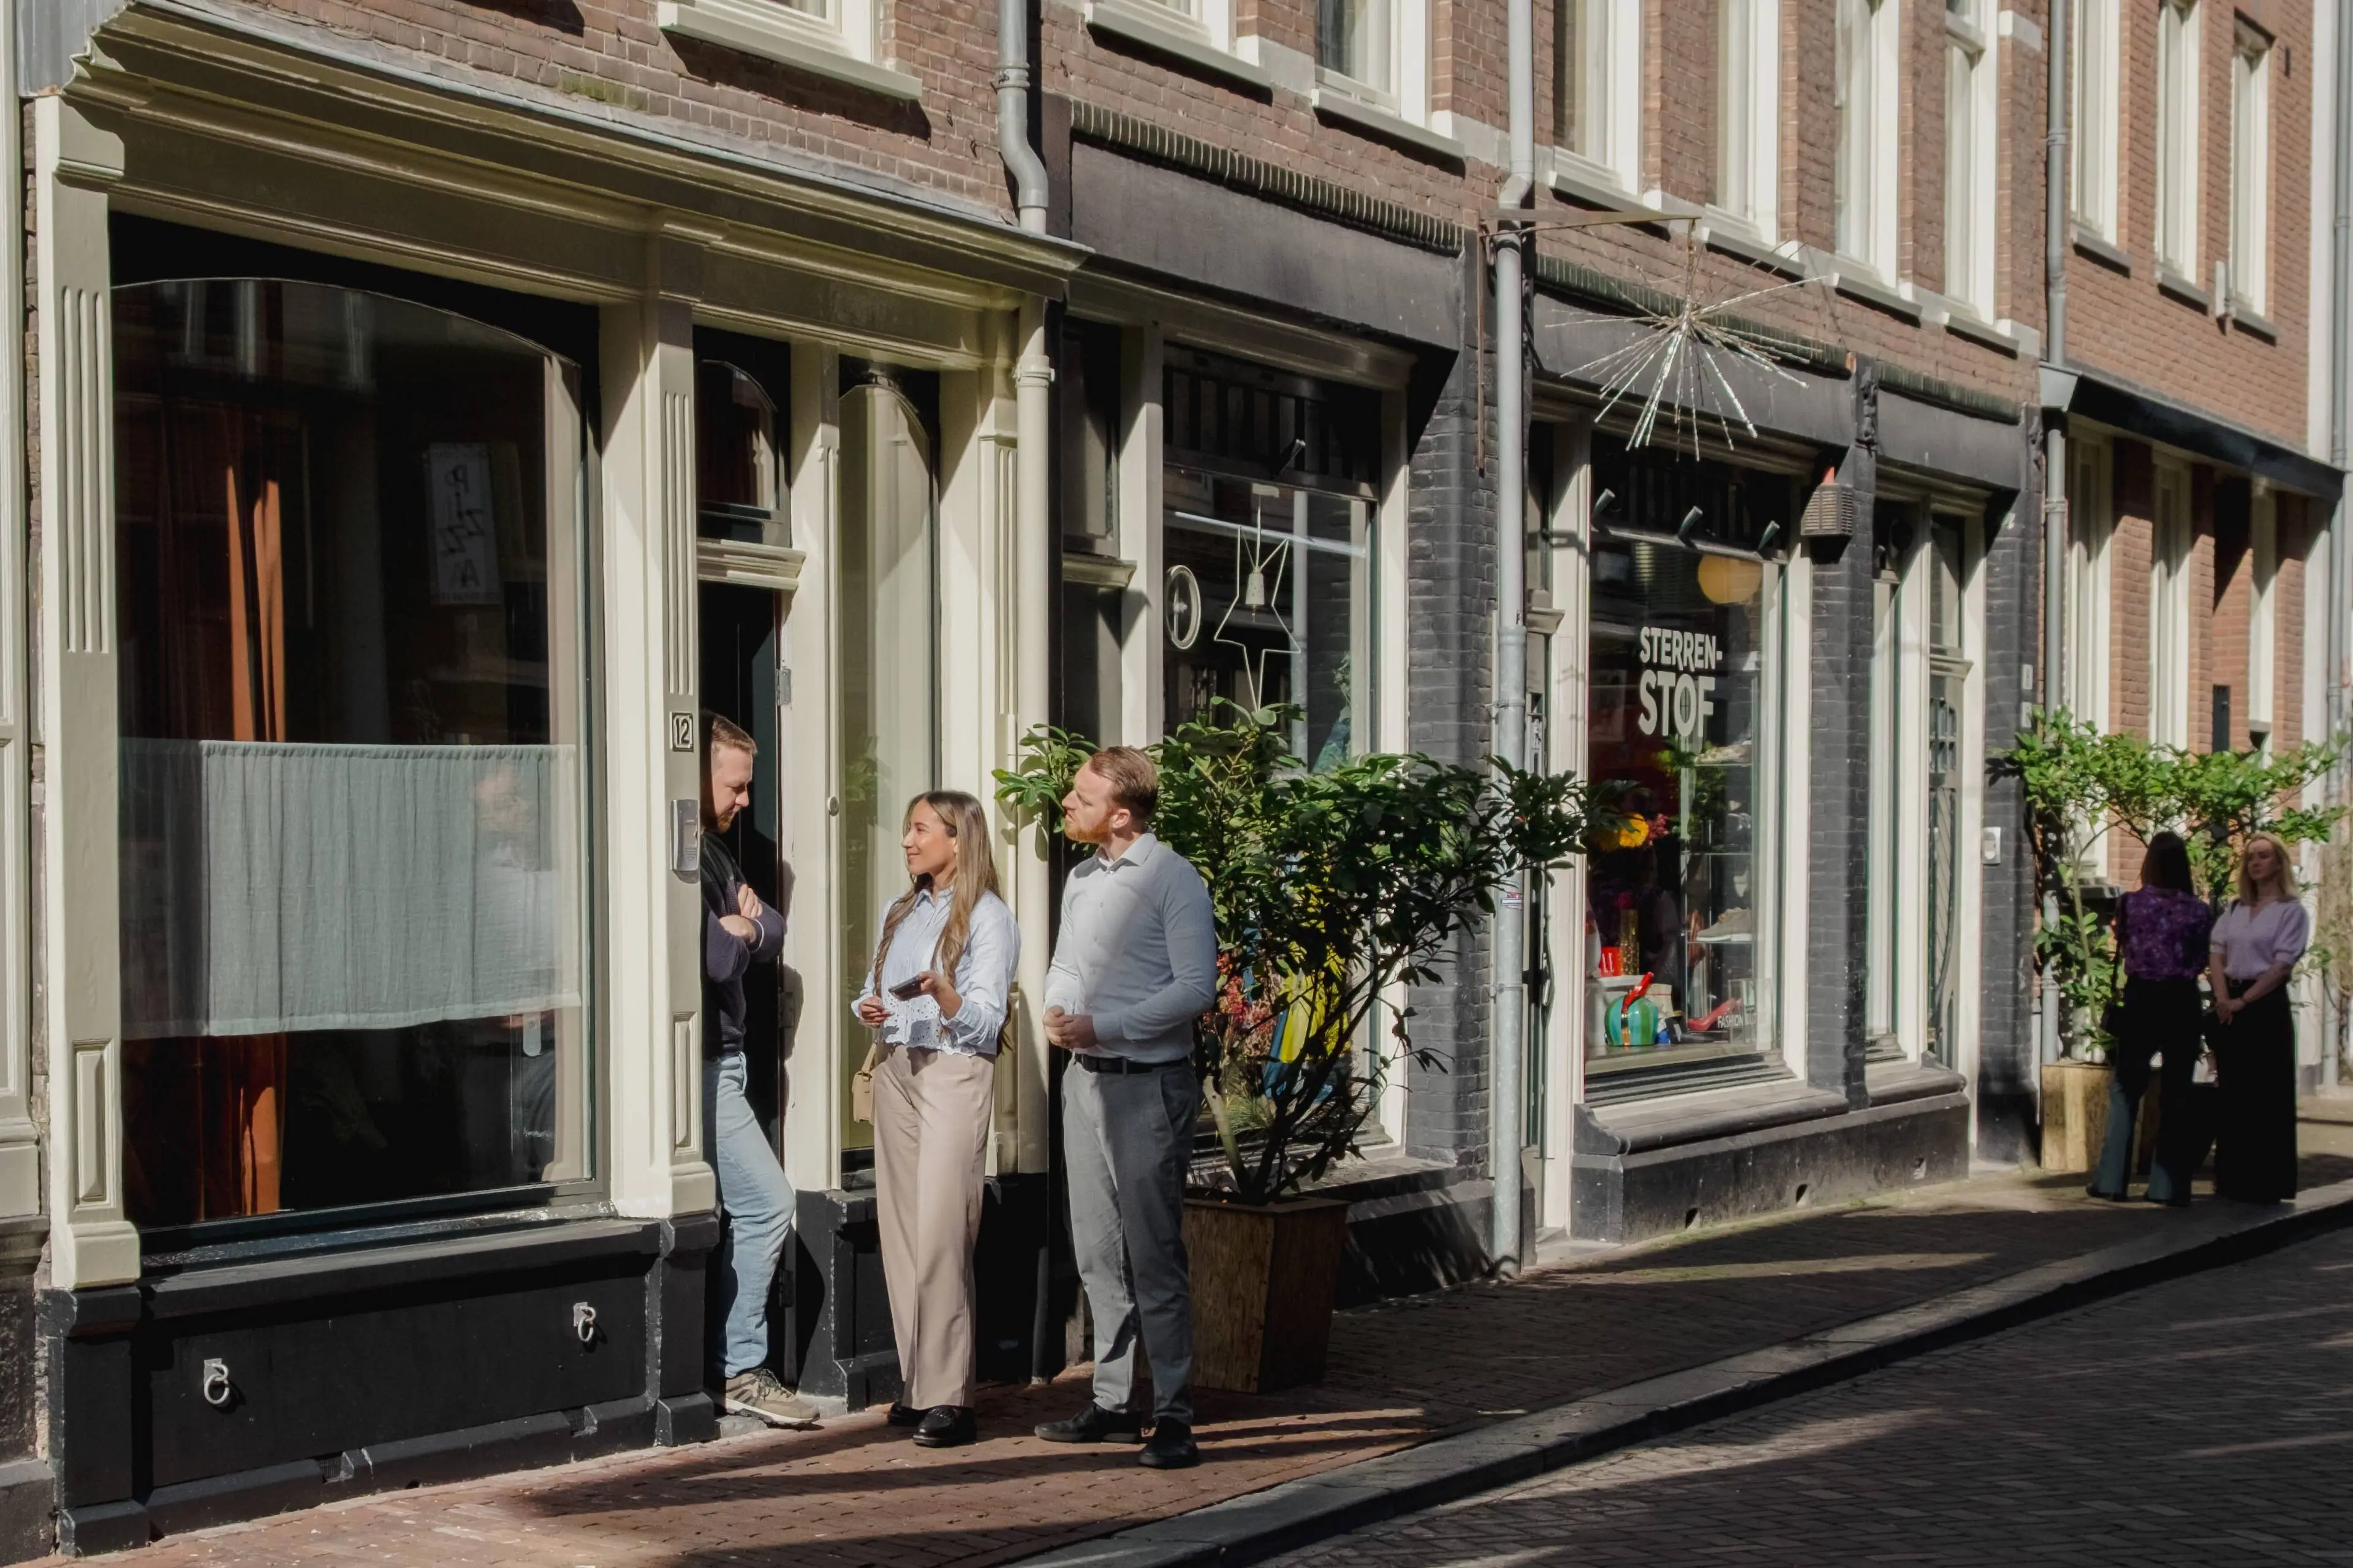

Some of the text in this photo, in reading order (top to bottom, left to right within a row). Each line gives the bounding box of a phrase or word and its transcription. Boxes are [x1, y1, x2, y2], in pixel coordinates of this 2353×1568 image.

[1639, 626, 1722, 672] STERREN-
[1638, 669, 1715, 737] STOF
[676, 718, 689, 744] 12
